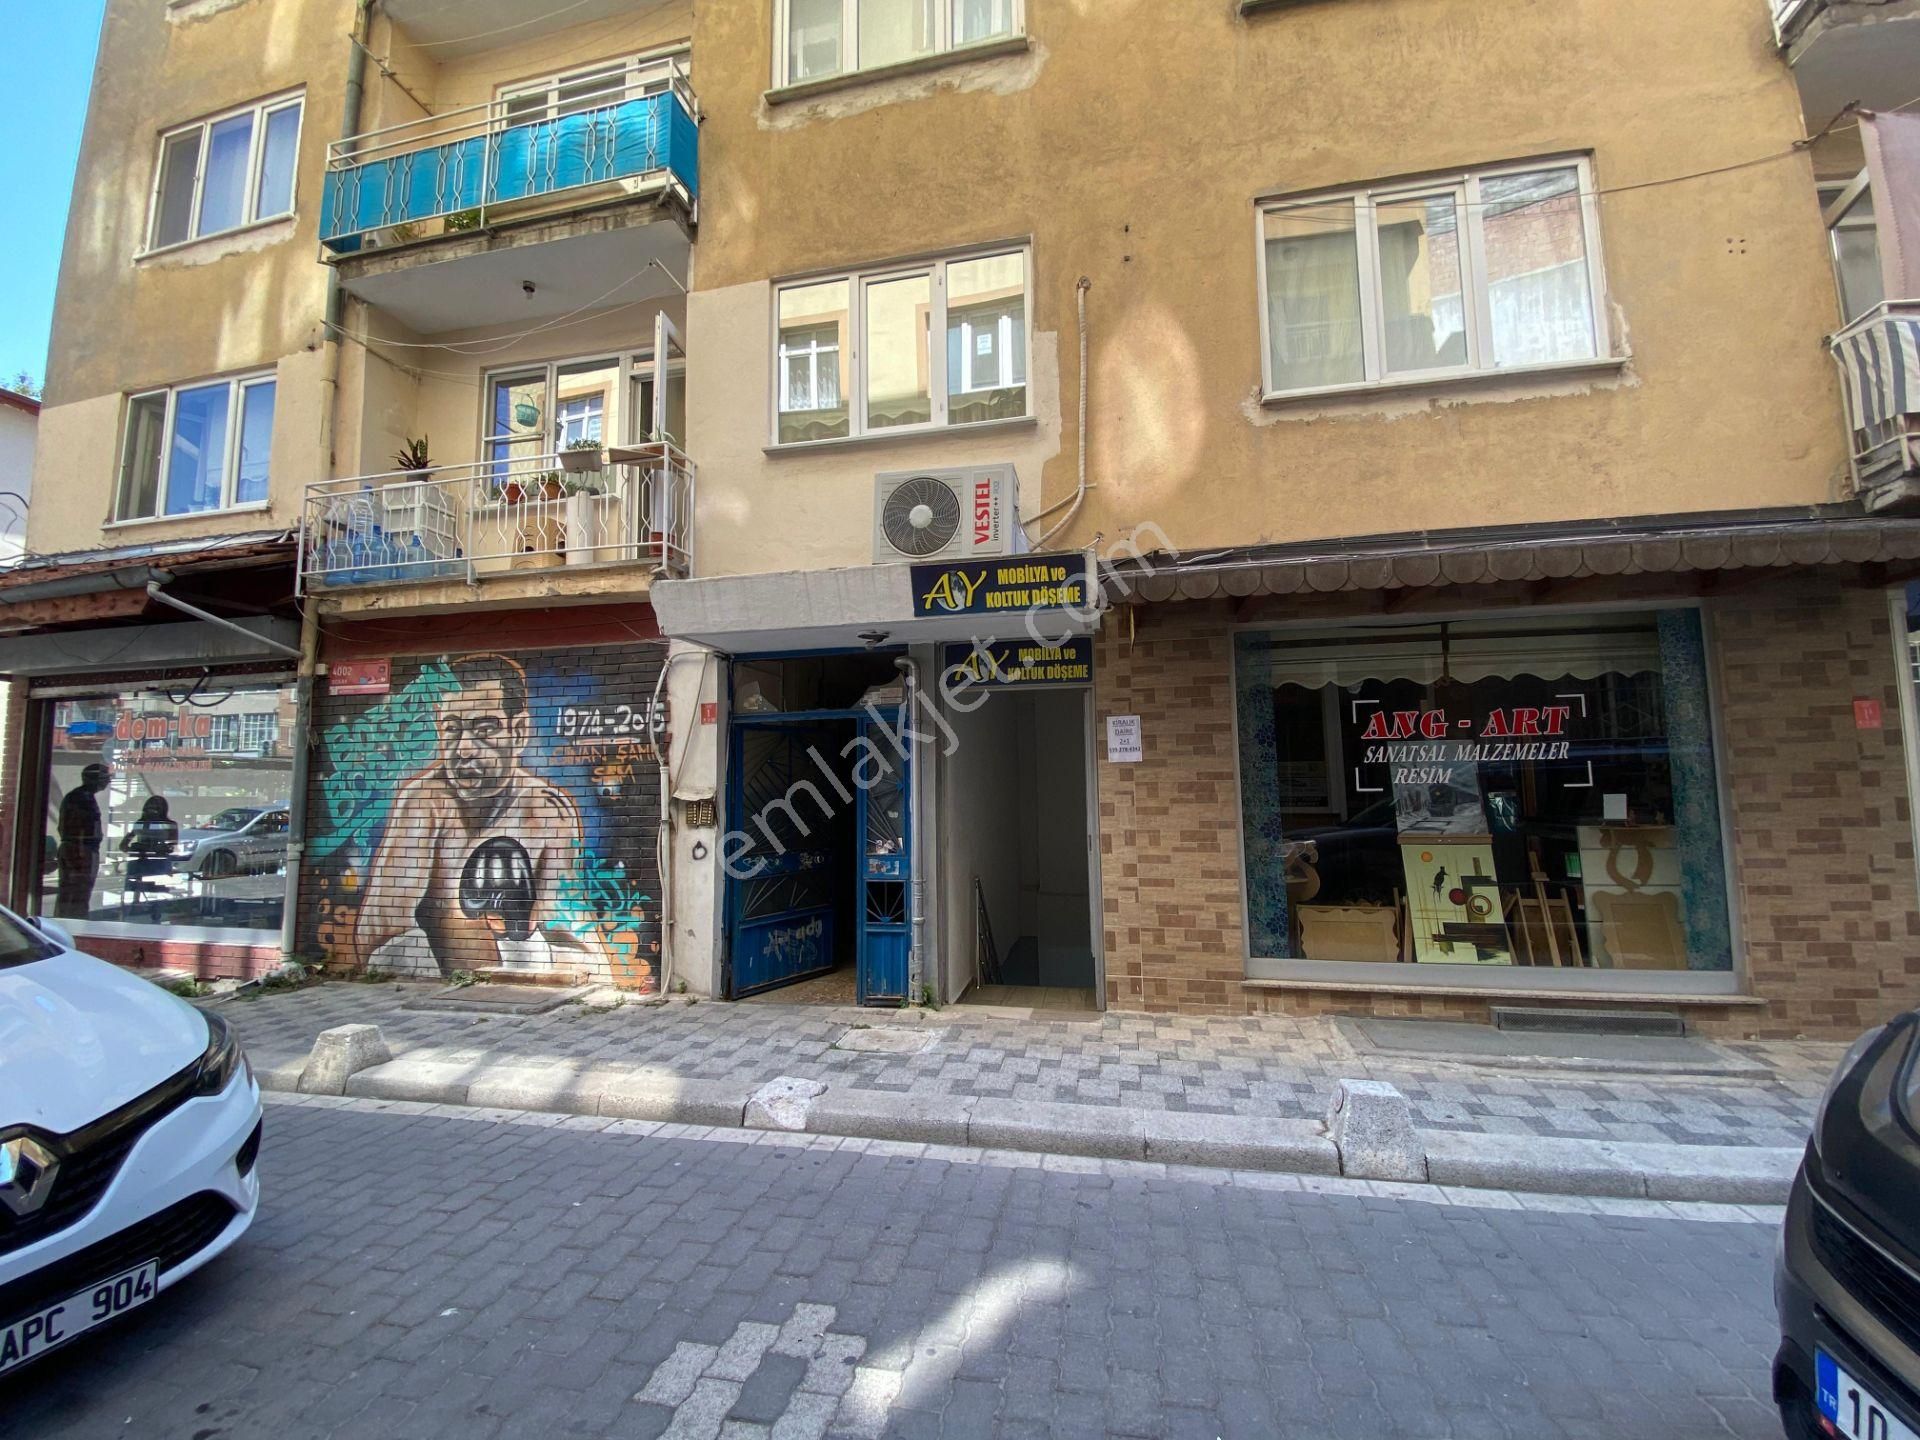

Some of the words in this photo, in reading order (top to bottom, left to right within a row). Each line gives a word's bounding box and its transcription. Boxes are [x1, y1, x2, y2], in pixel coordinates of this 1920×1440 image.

[974, 477, 991, 546] VESTEL
[997, 564, 1049, 585] MOBİLYA
[1051, 566, 1066, 581] ve
[922, 570, 987, 610] AY
[986, 590, 1031, 609] KOLTUK
[1031, 586, 1081, 608] DÖŞEME
[952, 649, 1009, 682] AY
[1018, 646, 1061, 662] MOBİLYA
[1063, 647, 1077, 660] ve
[1007, 666, 1046, 681] KOLTUK
[1047, 663, 1088, 682] DÖŞEME
[117, 706, 212, 741] dem-ka
[1361, 709, 1449, 740] ANG
[1480, 706, 1570, 738] ART
[1364, 745, 1447, 764] SANATSAL
[1454, 742, 1570, 763] MALZEMELER
[1394, 765, 1453, 785] RESİM
[0, 1306, 65, 1367] APC
[92, 1269, 152, 1321] 904
[1821, 1387, 1837, 1411] TR
